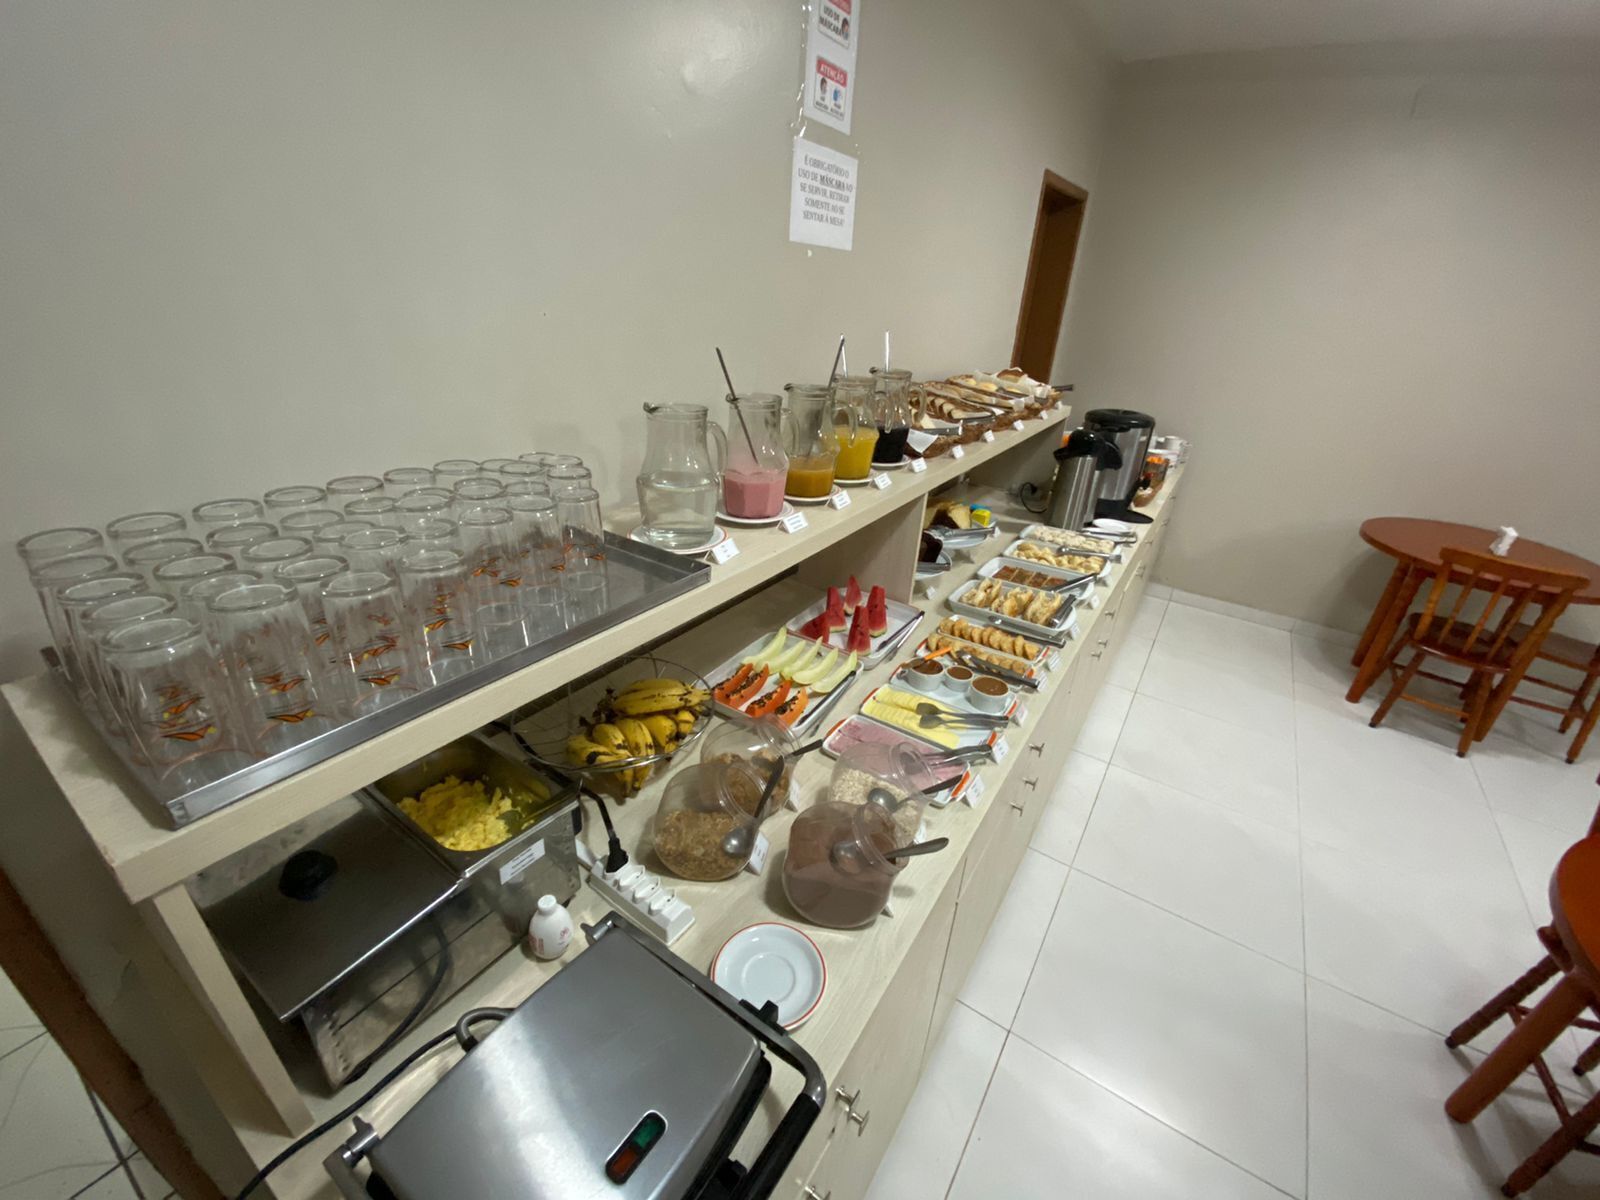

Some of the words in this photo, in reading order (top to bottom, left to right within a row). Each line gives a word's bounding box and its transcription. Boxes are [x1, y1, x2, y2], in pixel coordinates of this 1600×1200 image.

[820, 62, 845, 85] ATENÇÃO
[798, 167, 810, 180] USO
[811, 171, 818, 182] DE
[820, 173, 845, 192] MÁSCARA
[800, 182, 807, 193] SE
[804, 196, 830, 212] SOMENTE
[802, 210, 824, 223] SENTAR
